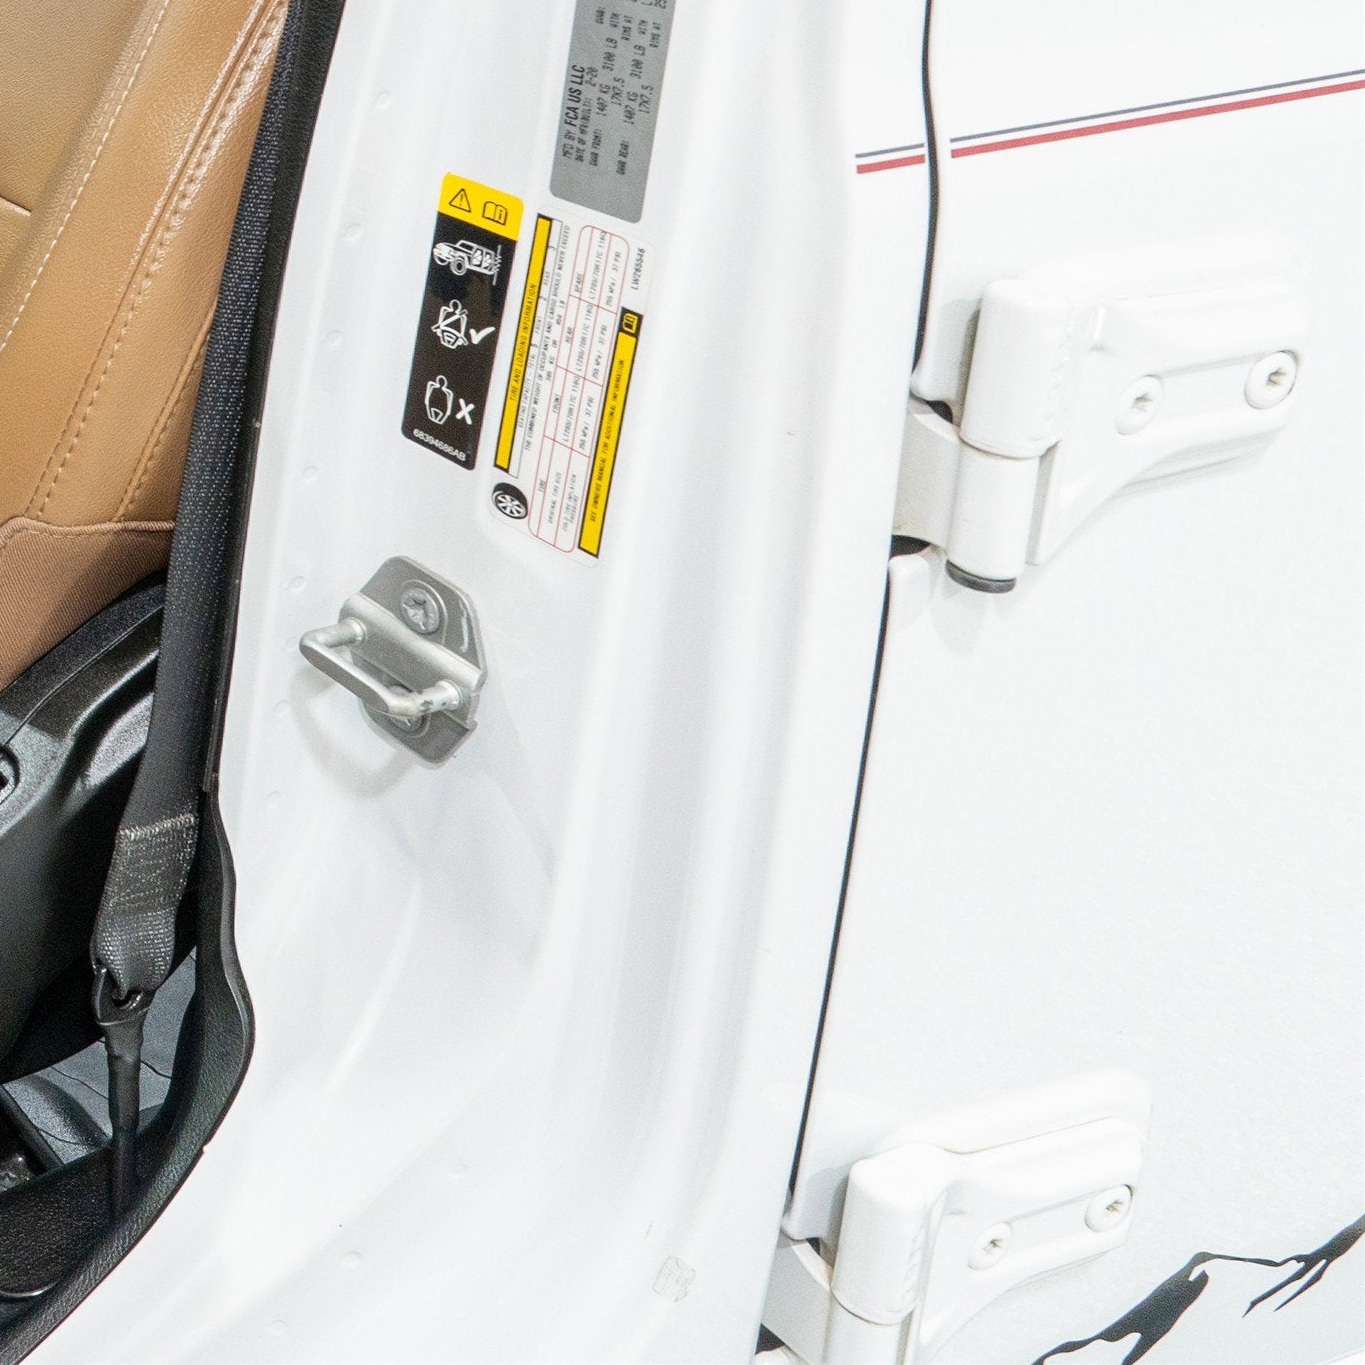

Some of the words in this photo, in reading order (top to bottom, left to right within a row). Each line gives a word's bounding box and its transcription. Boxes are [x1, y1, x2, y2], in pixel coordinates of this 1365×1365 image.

[605, 36, 617, 48] LB
[632, 44, 646, 56] LB
[602, 50, 615, 71] 3100
[629, 58, 643, 79] 3100
[569, 64, 585, 85] LLC
[584, 65, 598, 87] 2-20
[567, 86, 581, 102] US
[598, 82, 611, 94] KG
[610, 75, 625, 105] 17X7.5
[626, 90, 638, 102] KG
[638, 83, 653, 114] 17X7.5
[564, 104, 579, 126] FCA
[595, 97, 609, 117] 1407
[622, 104, 636, 125] 1407
[564, 129, 575, 140] BY
[561, 142, 573, 159] MFD
[630, 246, 646, 290] LW265546
[521, 282, 536, 333] INFORMATION
[515, 334, 527, 367] LOADING
[512, 367, 521, 383] AND
[509, 384, 518, 401] TIRE
